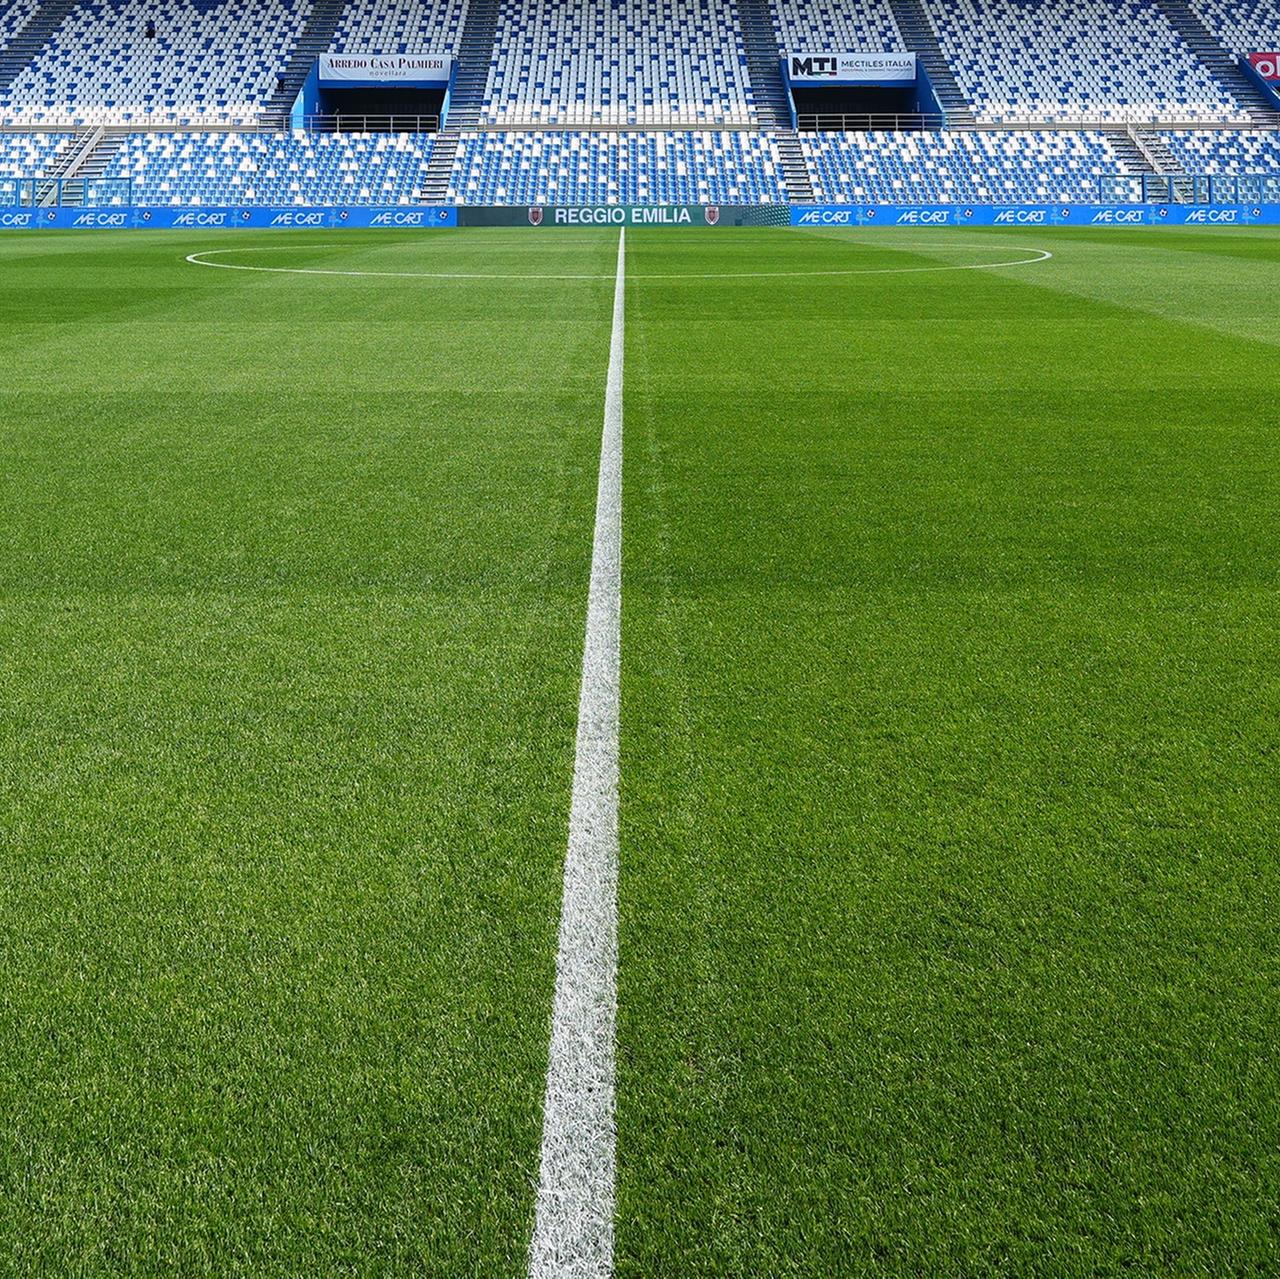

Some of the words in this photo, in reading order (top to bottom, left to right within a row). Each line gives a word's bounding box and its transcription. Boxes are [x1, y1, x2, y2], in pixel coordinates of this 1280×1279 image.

[792, 57, 837, 76] MTI
[841, 60, 884, 68] MECTILES
[555, 208, 625, 223] REGGIO
[632, 208, 691, 223] EMILIA
